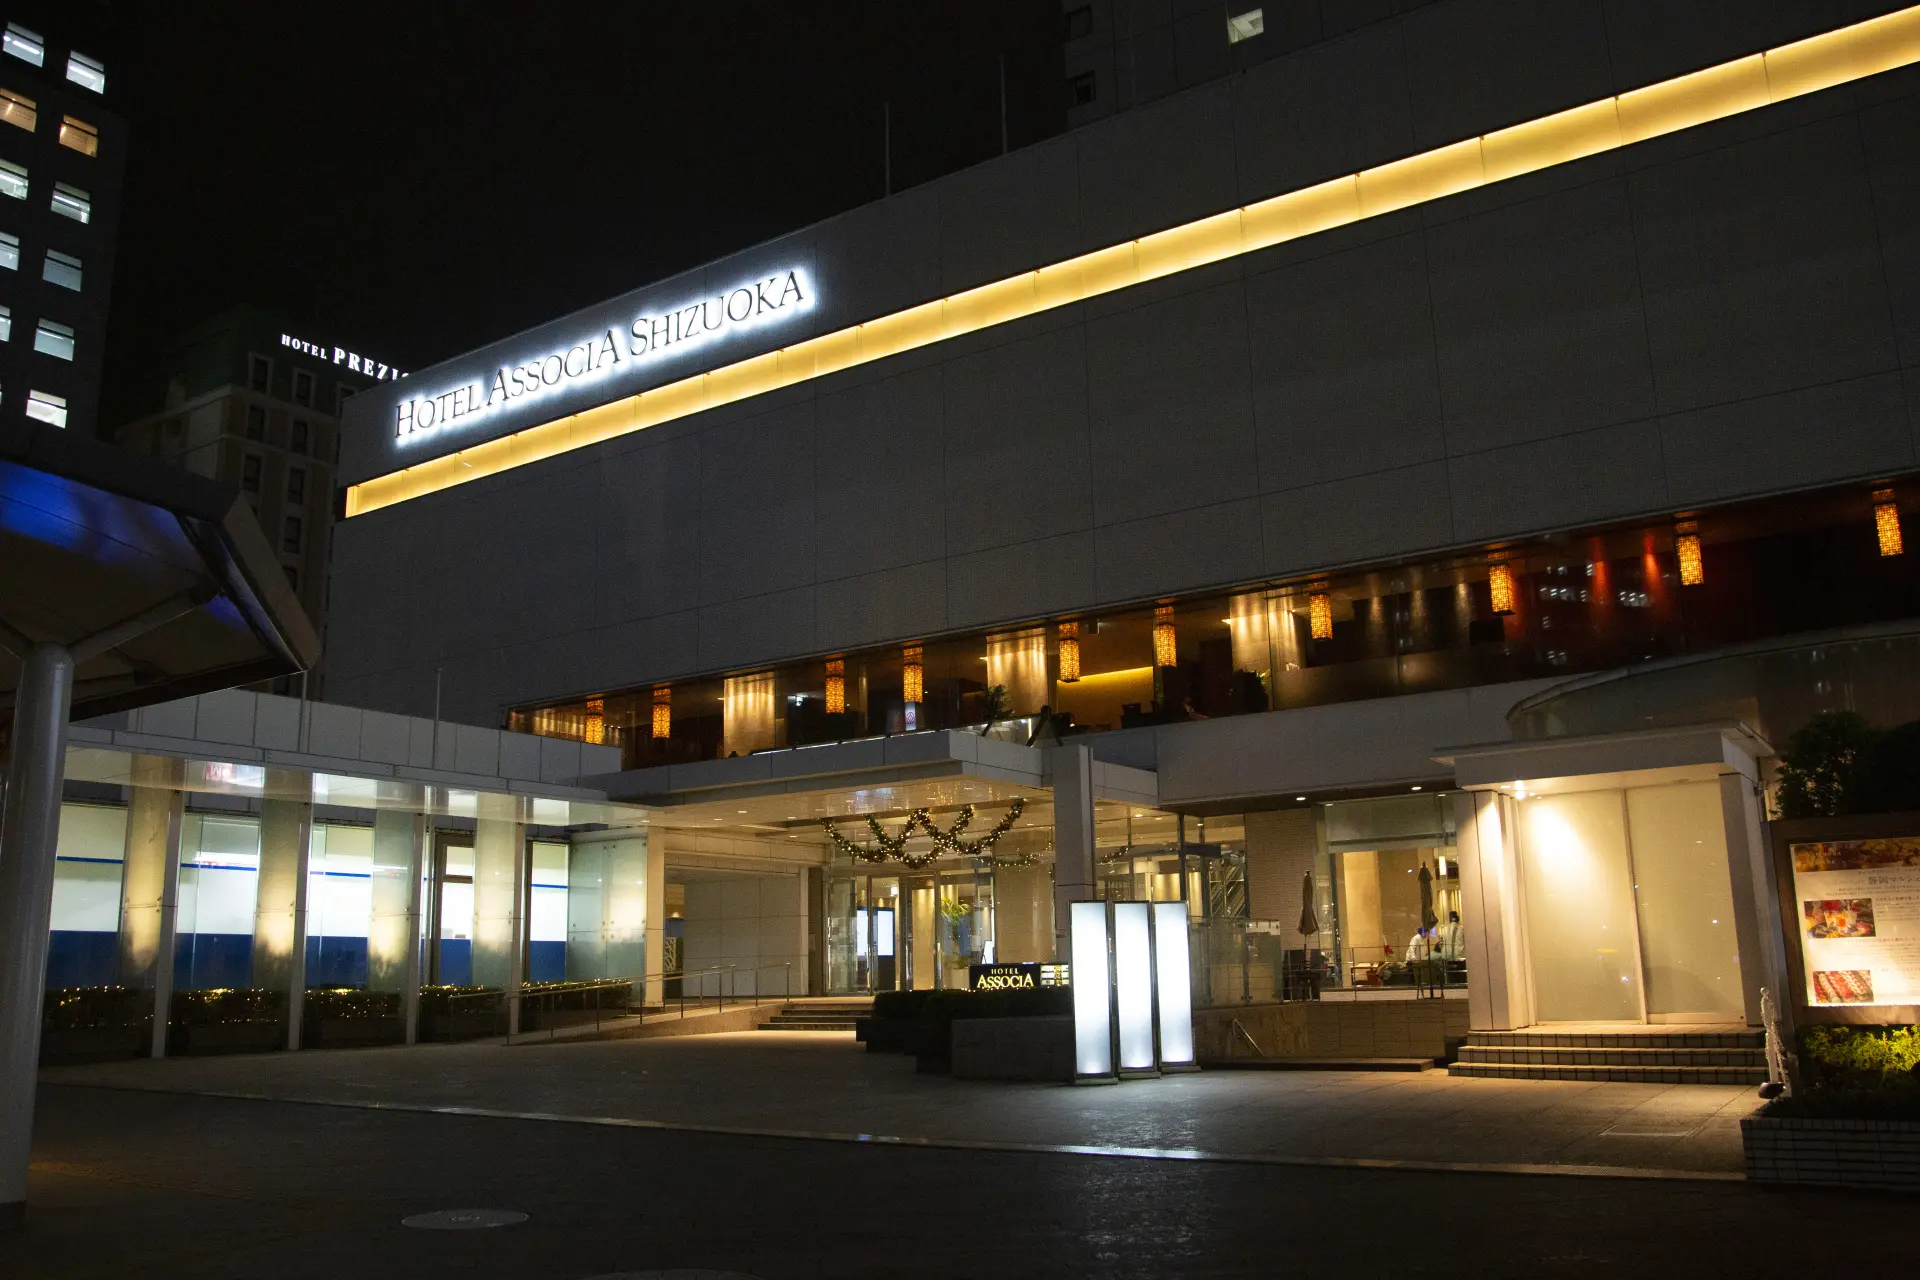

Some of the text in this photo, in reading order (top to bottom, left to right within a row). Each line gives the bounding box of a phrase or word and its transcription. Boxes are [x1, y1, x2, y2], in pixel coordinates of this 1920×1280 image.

[281, 333, 410, 381] HOTEL PREZI
[394, 270, 805, 438] HOTEL ASSOCIA SHIZUOKA
[977, 973, 1034, 988] ASSOCIA
